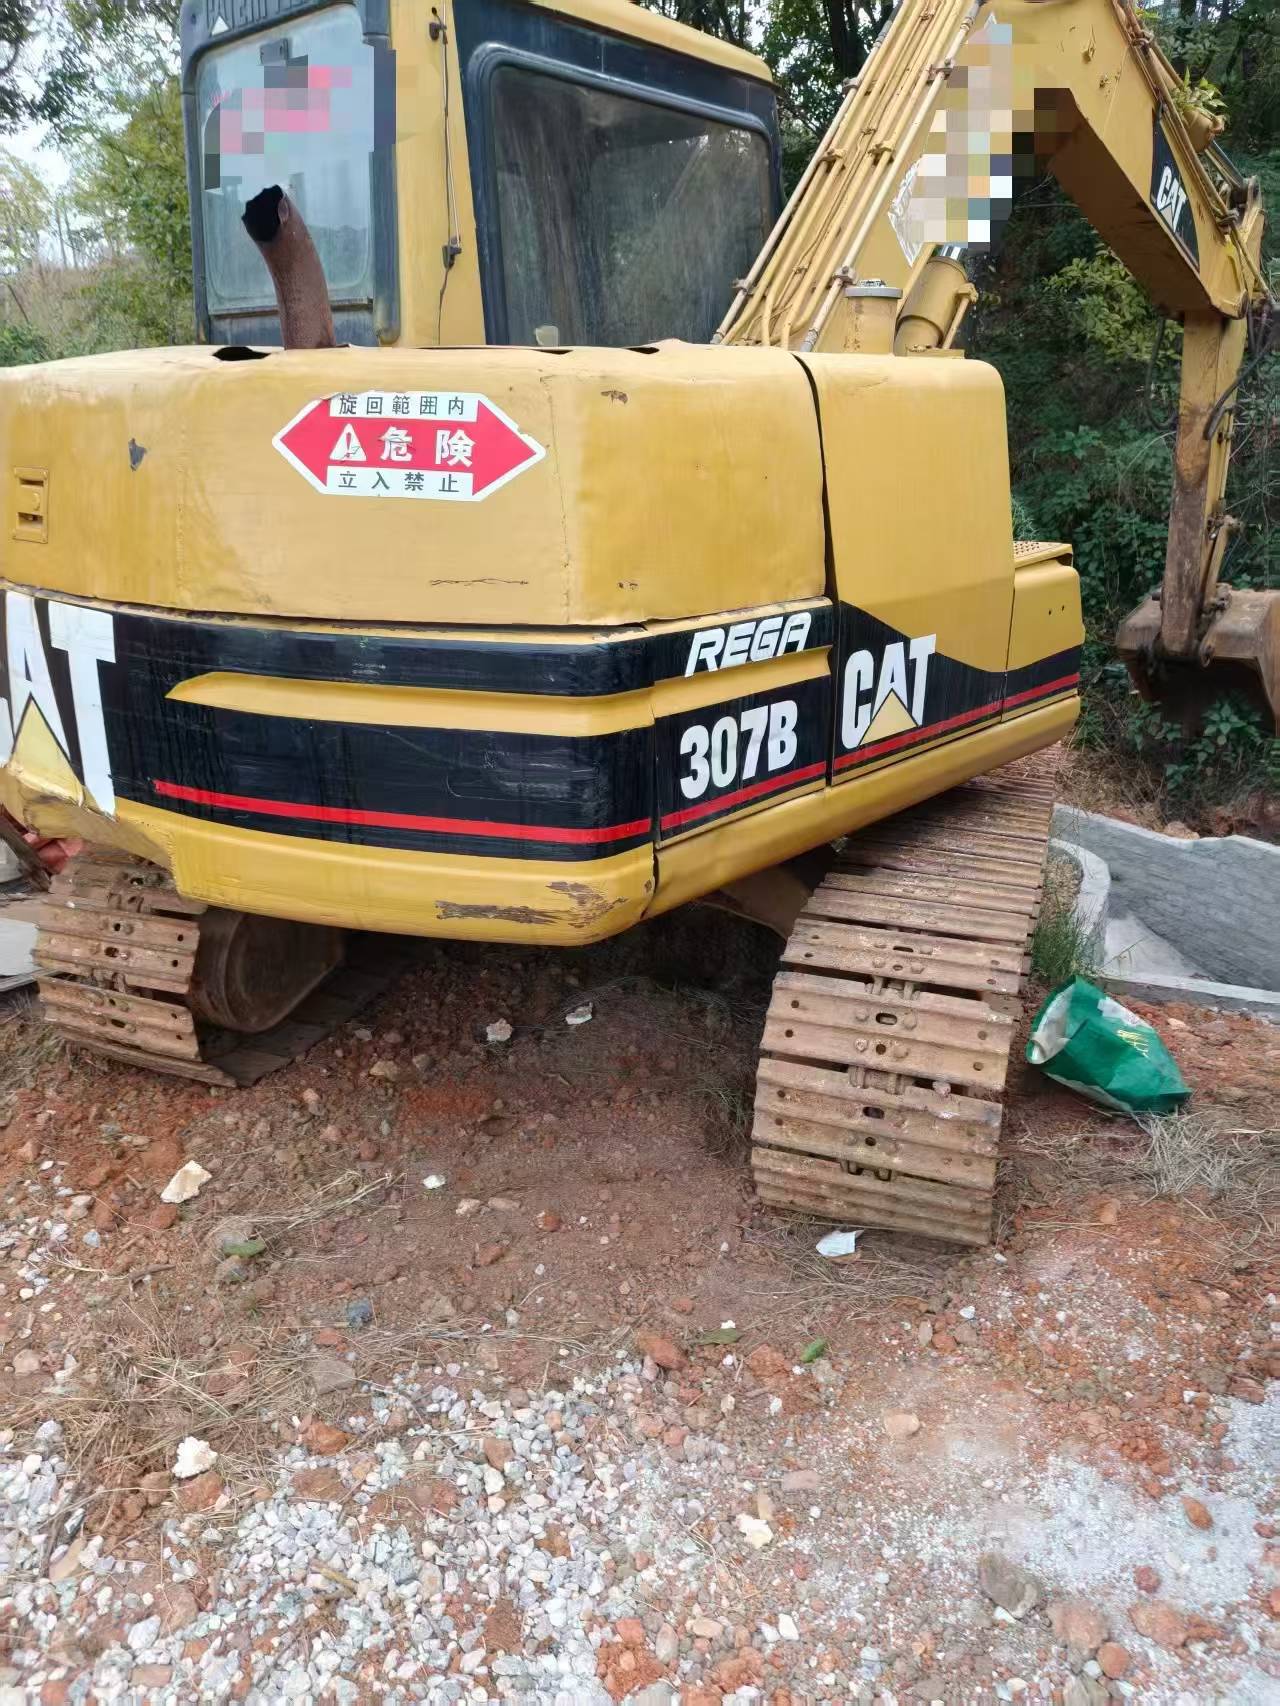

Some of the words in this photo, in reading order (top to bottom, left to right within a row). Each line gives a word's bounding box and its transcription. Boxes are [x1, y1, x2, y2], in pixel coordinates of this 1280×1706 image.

[1156, 166, 1187, 233] CAT
[338, 394, 464, 416] 旋回範囲内
[378, 426, 475, 467] 危険
[338, 471, 459, 493] 立入禁止
[684, 611, 812, 677] REGA
[0, 590, 117, 822] AT
[841, 633, 937, 749] CAT
[679, 699, 798, 799] 307B
